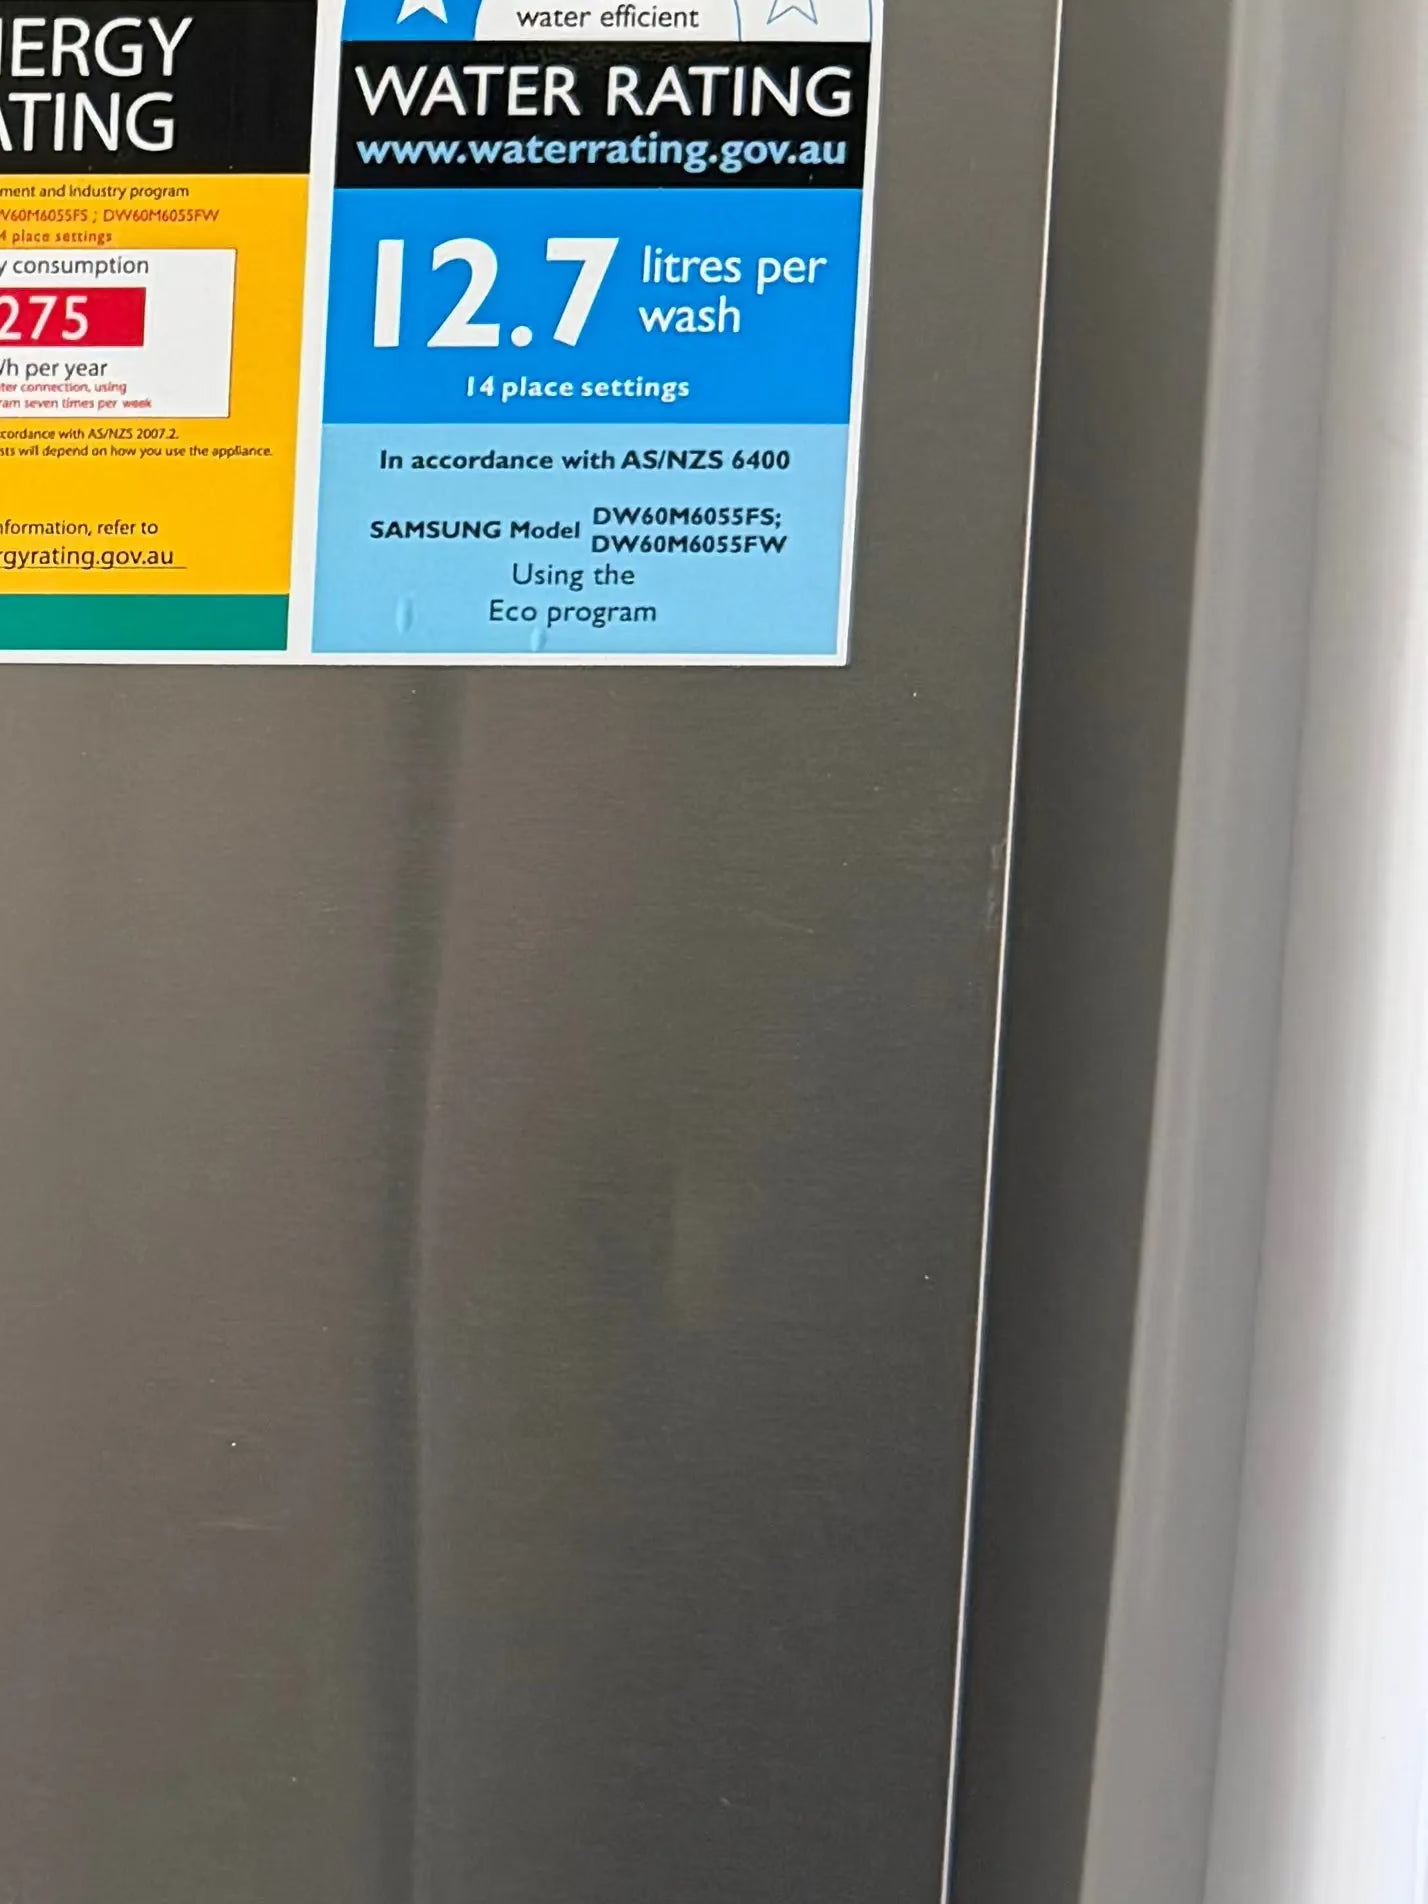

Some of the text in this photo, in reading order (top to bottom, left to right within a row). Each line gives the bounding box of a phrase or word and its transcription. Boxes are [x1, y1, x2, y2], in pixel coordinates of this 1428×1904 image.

[516, 2, 700, 29] water efficient
[353, 64, 854, 117] WATER RATING
[356, 131, 848, 173] www.waterrating.gov.au
[39, 184, 66, 197] and
[69, 184, 126, 201] industry
[129, 185, 190, 201] program
[11, 229, 50, 245] place
[54, 230, 113, 246] settings
[12, 255, 150, 277] consumption
[641, 244, 829, 295] litres per
[372, 235, 620, 349] 12.7
[638, 295, 741, 334] wash
[25, 361, 60, 381] per
[64, 361, 109, 381] year
[94, 381, 127, 395] using
[465, 374, 691, 404] 14 place settings
[24, 399, 59, 409] seven
[61, 397, 94, 409] times
[97, 399, 118, 412] per
[122, 397, 152, 409] week
[58, 427, 85, 440] with
[87, 427, 133, 440] AS/NZS
[18, 445, 39, 457] will
[42, 445, 89, 459] depend
[92, 447, 108, 457] on
[110, 445, 137, 457] how
[139, 447, 162, 459] you
[165, 447, 186, 457] use
[188, 445, 209, 457] the
[379, 448, 791, 473] In accordance with AS/NZS 6400
[97, 518, 136, 536] refer
[140, 520, 159, 536] to
[592, 506, 783, 529] DW60M6055FS;
[369, 519, 581, 541] SAMSUNG Model
[590, 534, 789, 555] DW60M6055FW
[512, 562, 636, 592] Using the
[488, 599, 658, 628] Eco program
